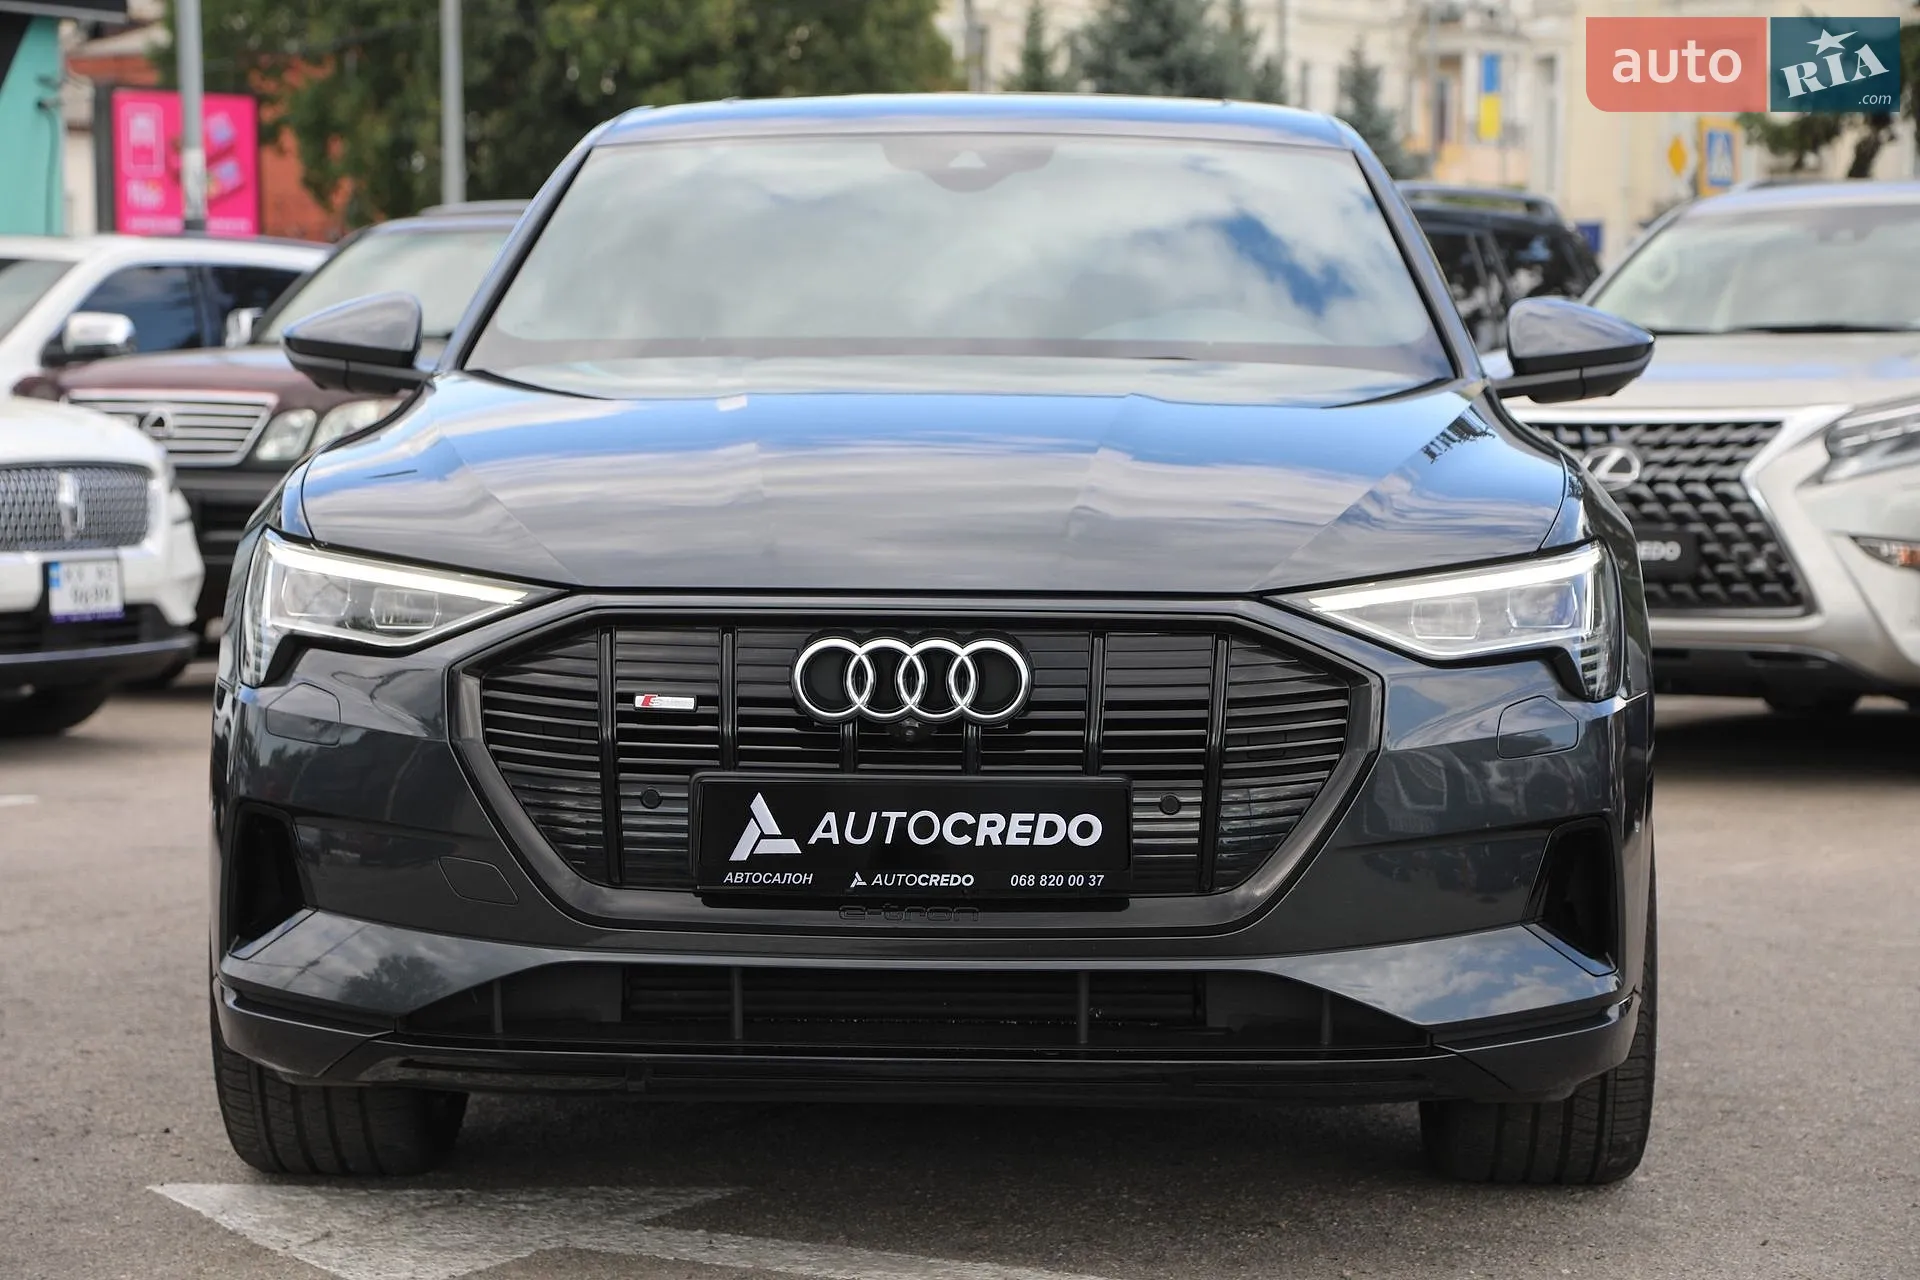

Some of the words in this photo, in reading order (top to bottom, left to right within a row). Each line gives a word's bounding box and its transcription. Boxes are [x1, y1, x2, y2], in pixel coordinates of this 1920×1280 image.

[807, 810, 1103, 847] AUTOCREDO
[723, 871, 814, 885] АВТОСАЛОН
[871, 873, 975, 887] AUTOCREDO
[1010, 873, 1035, 887] 068
[1039, 873, 1064, 887] 820
[1067, 873, 1085, 887] 00
[1088, 873, 1105, 887] 37
[838, 902, 980, 922] e-tron
